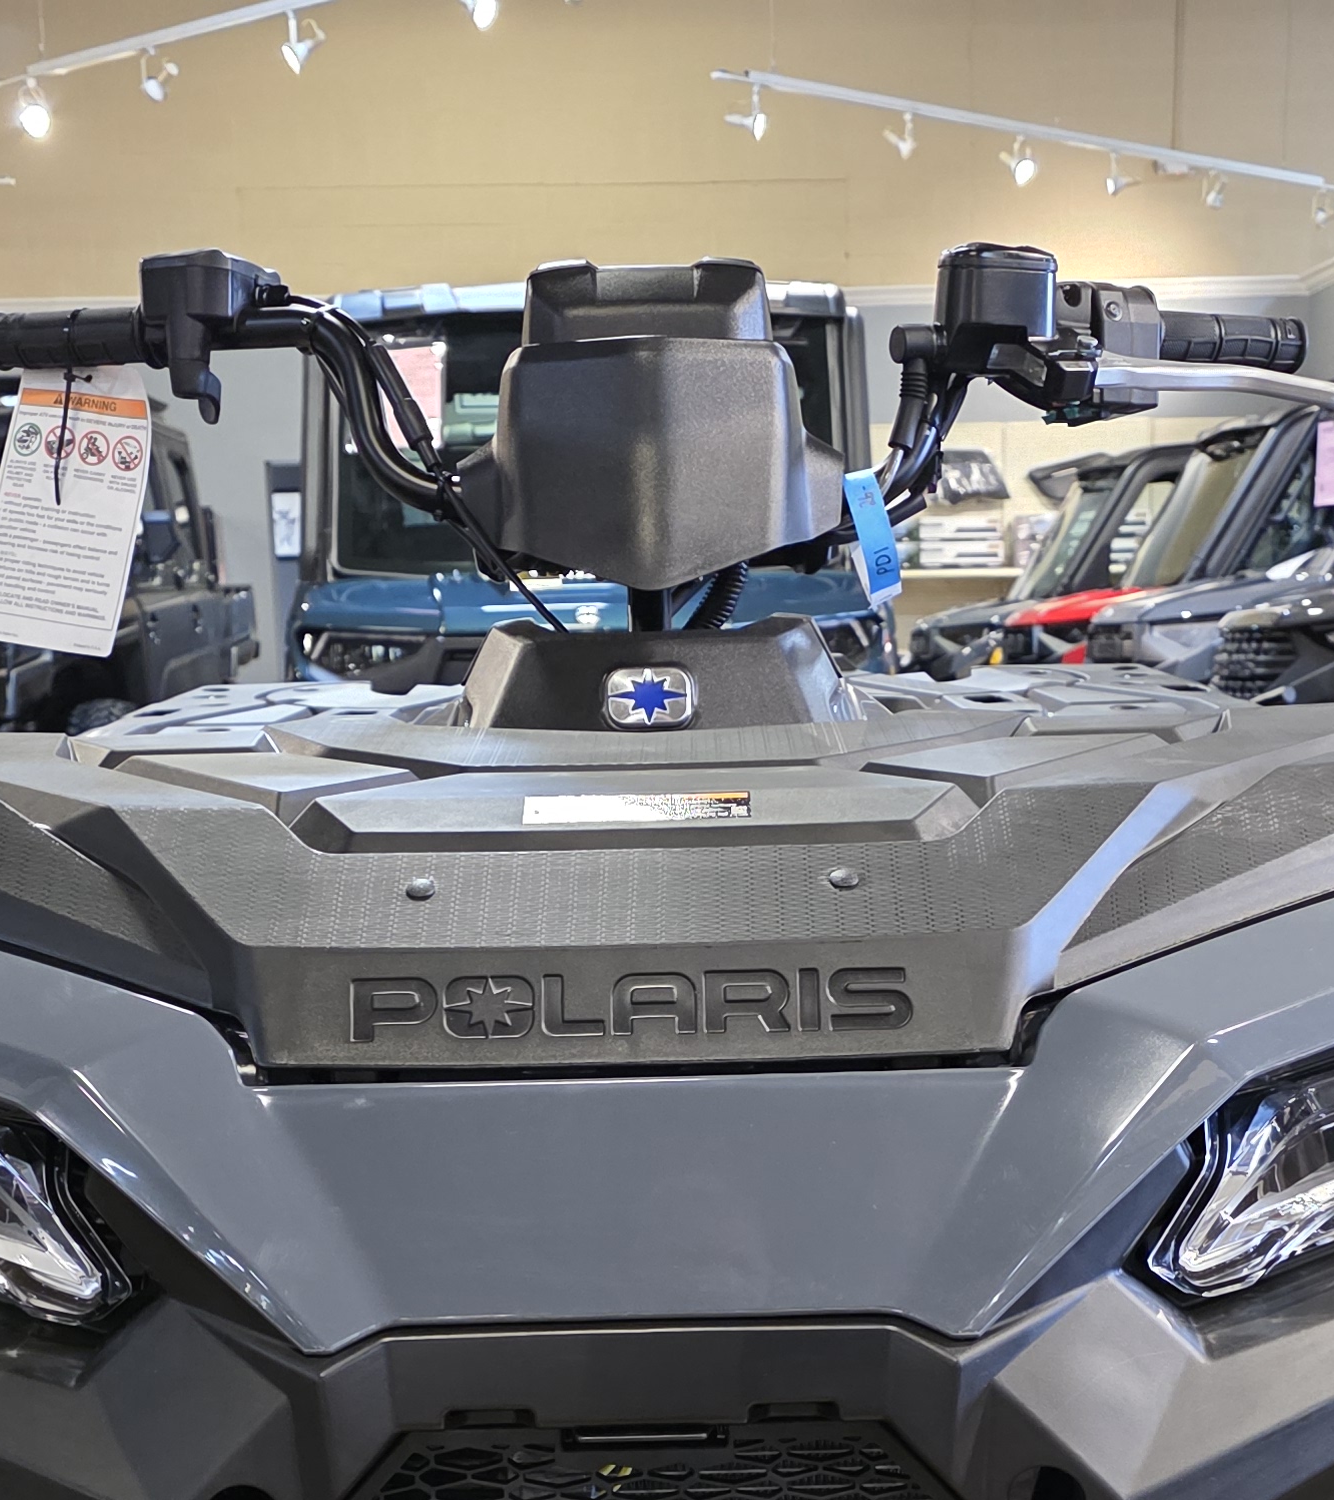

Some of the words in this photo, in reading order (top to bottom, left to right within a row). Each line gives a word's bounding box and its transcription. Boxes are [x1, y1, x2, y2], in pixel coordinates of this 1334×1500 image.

[69, 396, 117, 412] WARNING
[874, 546, 895, 576] PDI
[349, 966, 913, 1044] POLARIS
